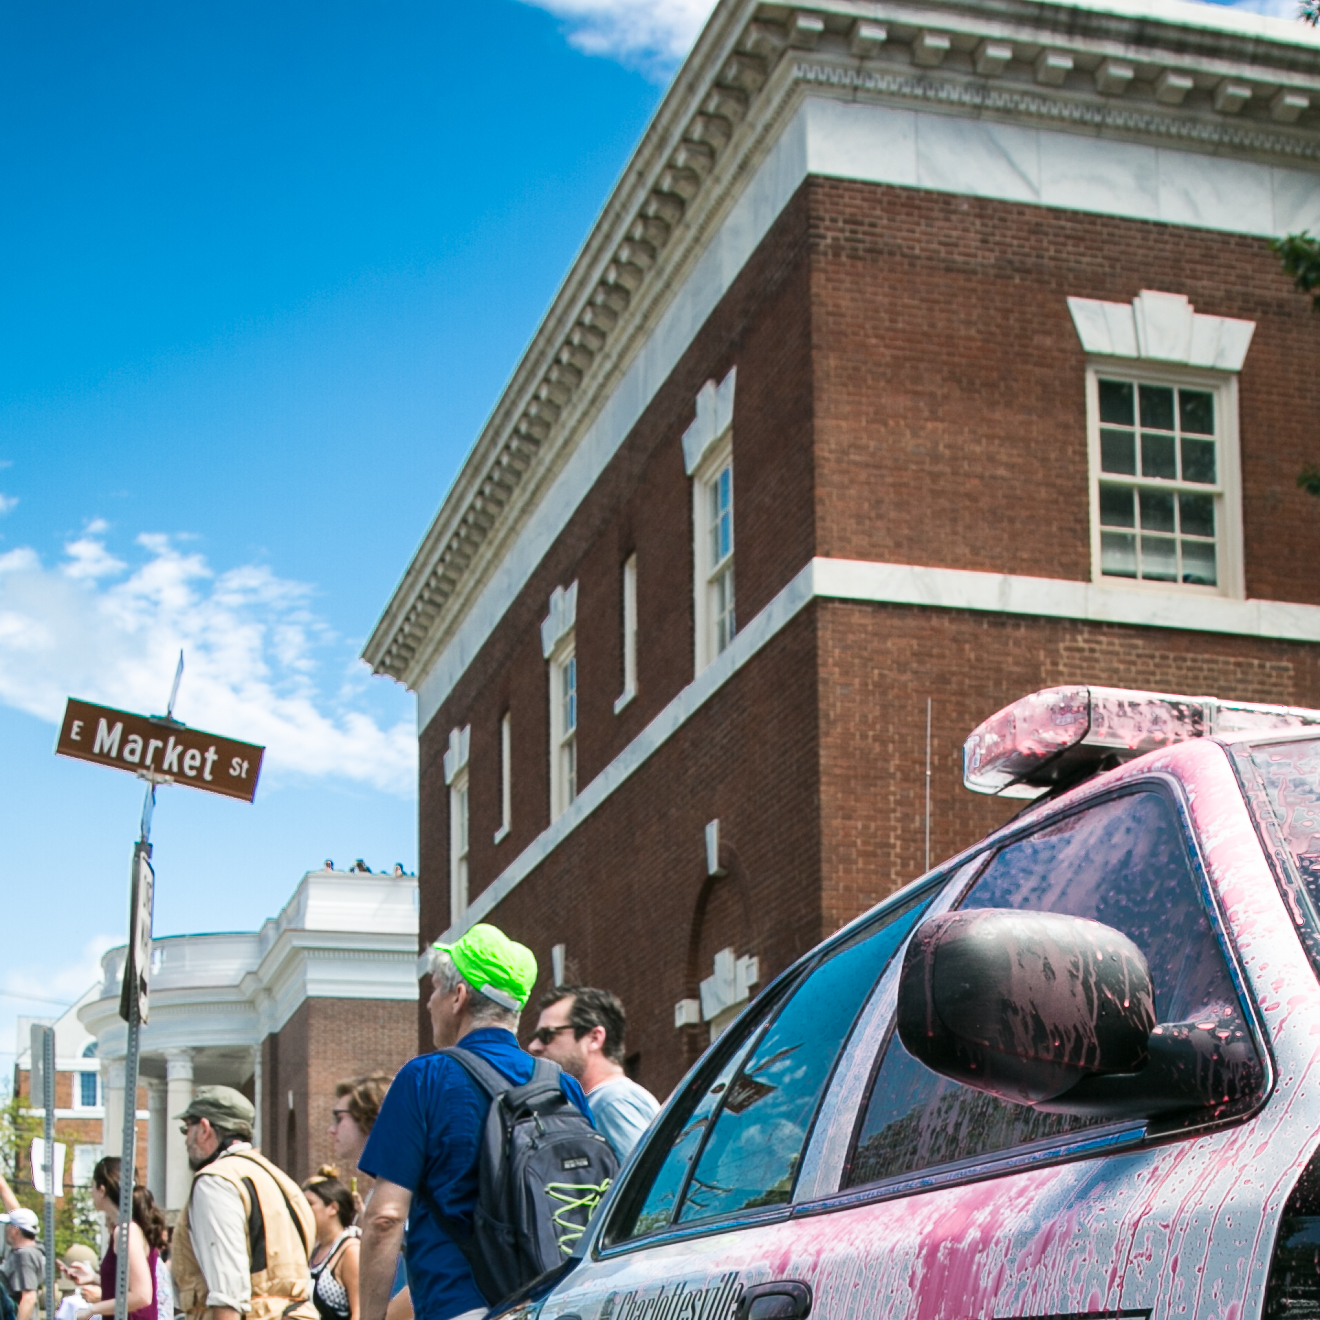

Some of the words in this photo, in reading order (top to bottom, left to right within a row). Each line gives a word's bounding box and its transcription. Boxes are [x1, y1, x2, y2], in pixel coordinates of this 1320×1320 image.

[70, 720, 84, 741] E
[93, 717, 218, 781] Market
[228, 756, 250, 779] St
